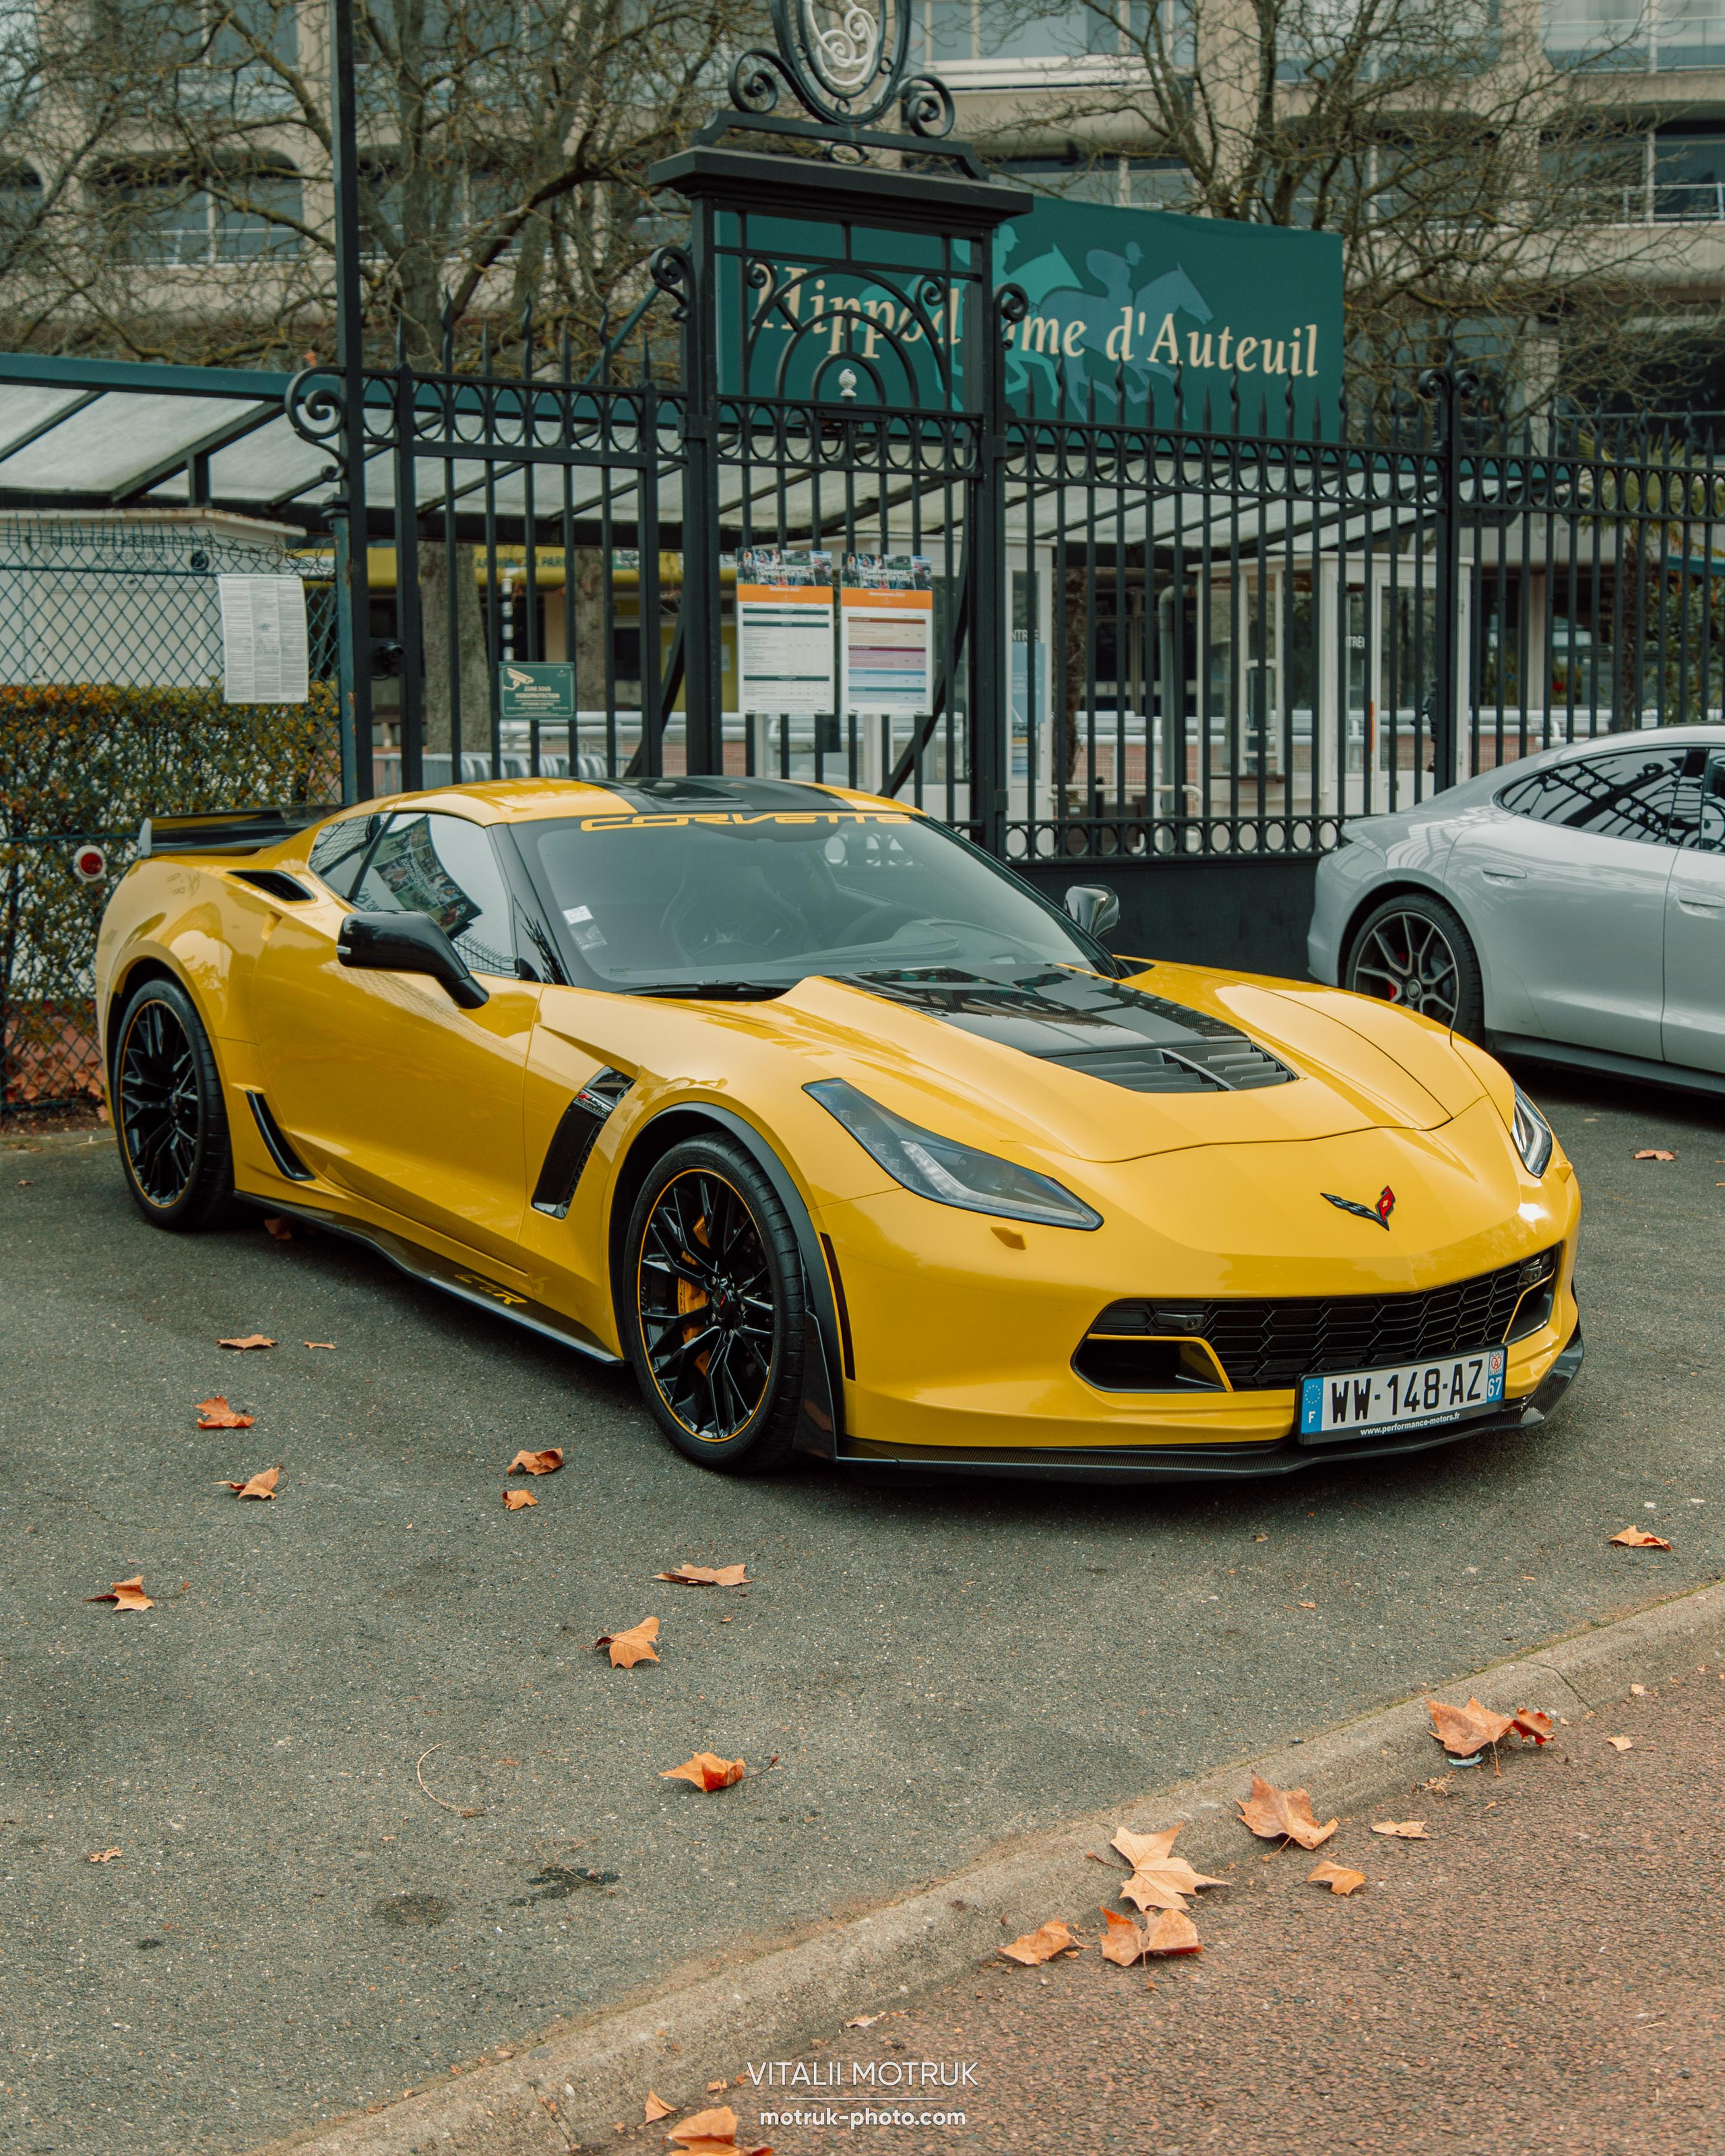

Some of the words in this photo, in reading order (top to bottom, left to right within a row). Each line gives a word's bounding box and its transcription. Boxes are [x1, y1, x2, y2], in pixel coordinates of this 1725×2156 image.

[754, 263, 1087, 358] Hippodme
[1106, 306, 1319, 377] d'Auteuil
[581, 812, 912, 831] CORVETTE
[1308, 1411, 1316, 1424] F
[1331, 1359, 1483, 1424] WW-148-AZ
[1487, 1376, 1503, 1397] 67
[1360, 1412, 1460, 1436] www.performance-motors.fr
